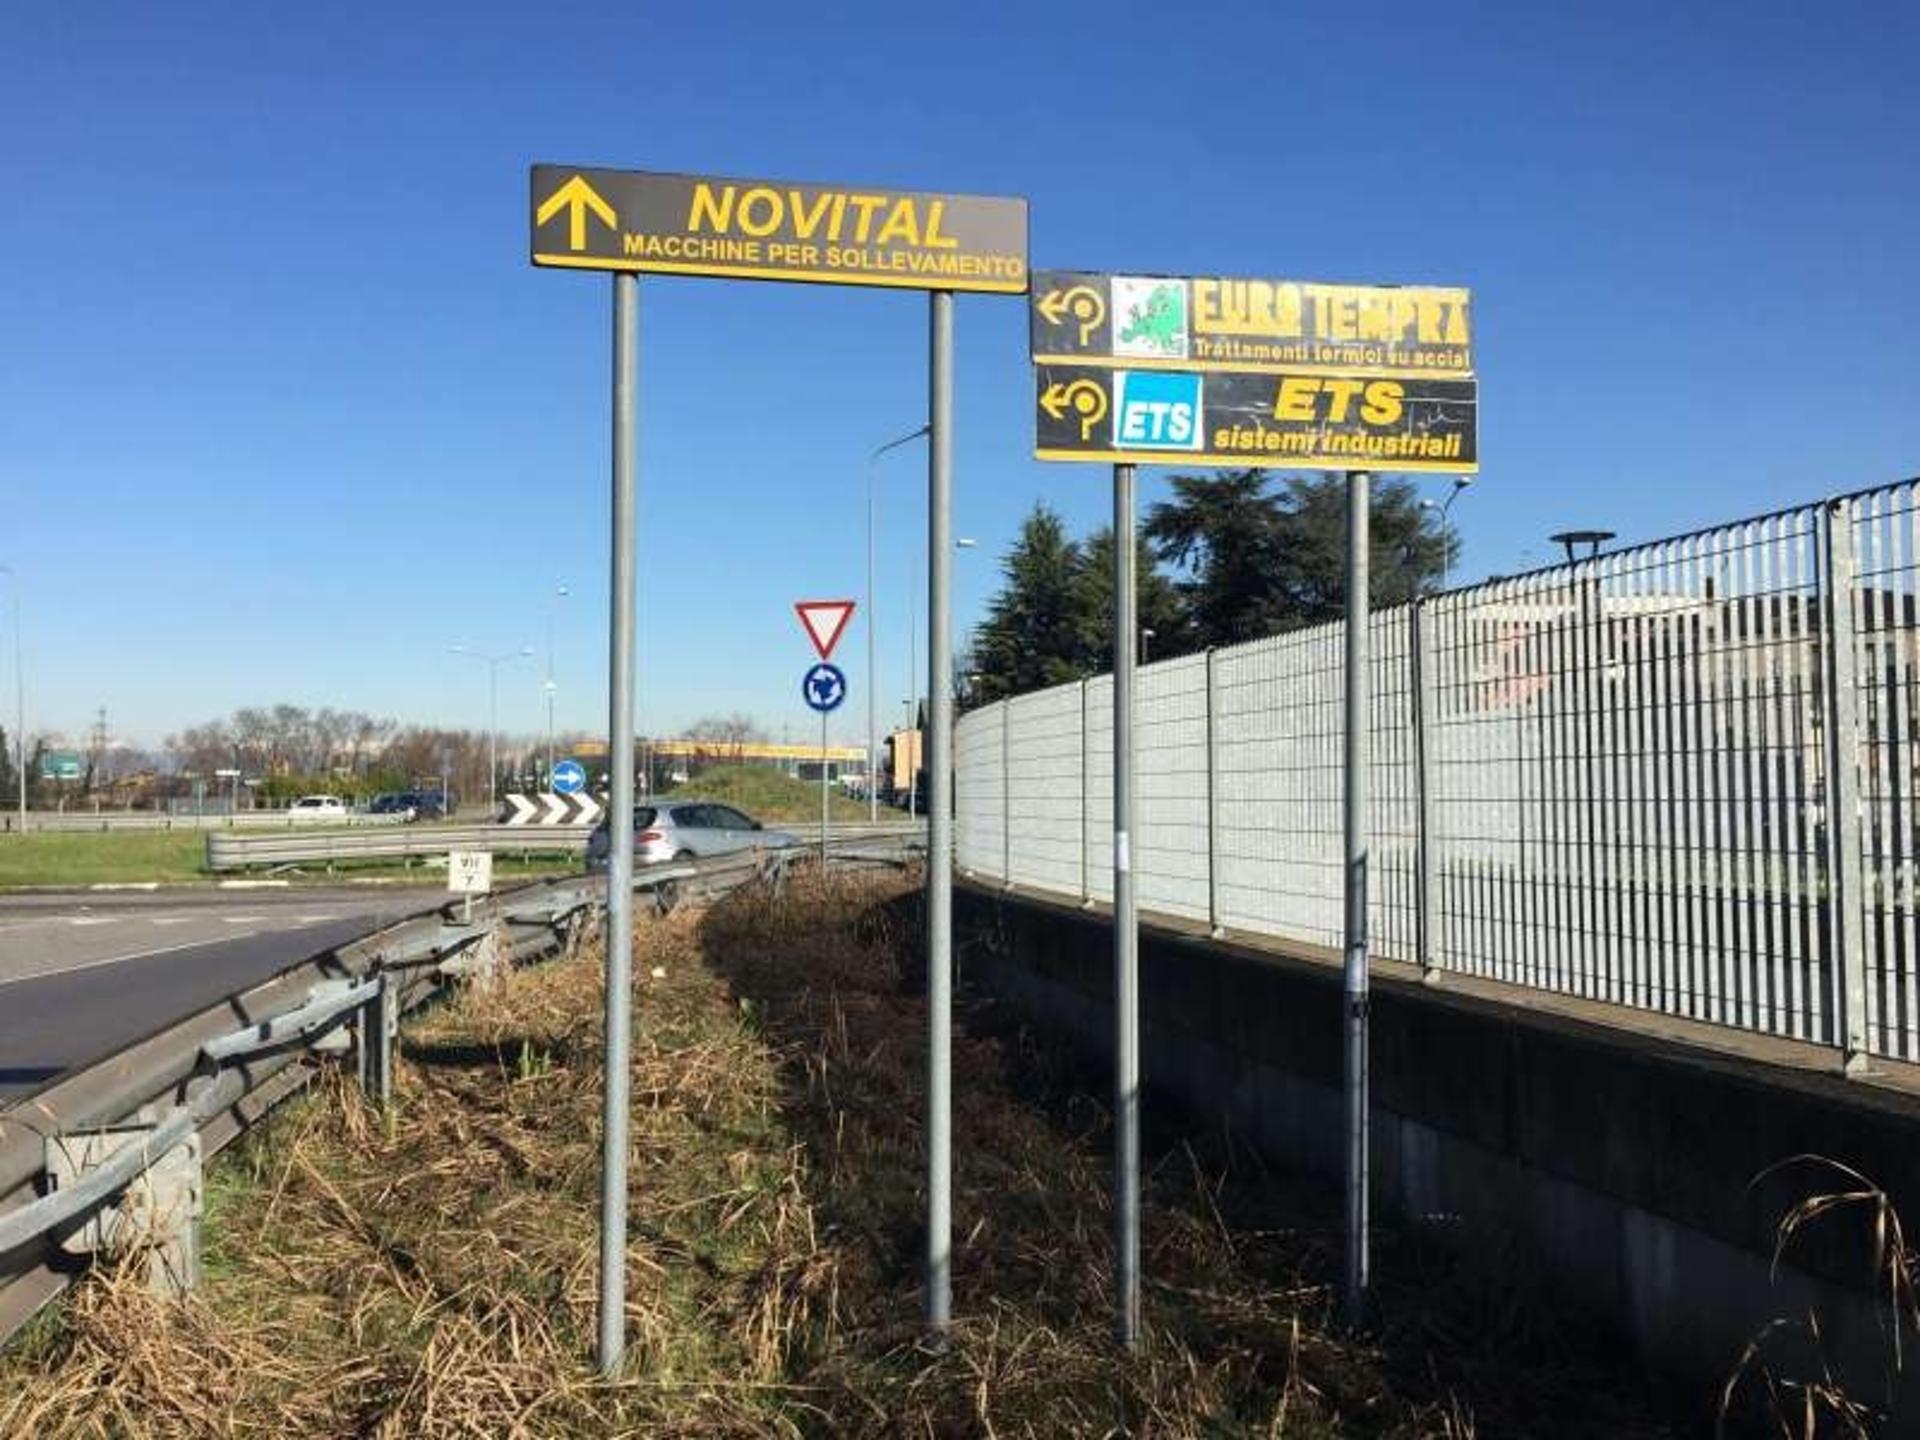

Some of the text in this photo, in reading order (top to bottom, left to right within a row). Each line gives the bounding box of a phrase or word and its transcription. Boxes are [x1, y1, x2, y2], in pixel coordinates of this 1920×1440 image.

[688, 184, 958, 249] NOVITAL
[623, 233, 1023, 278] MACCHINE PER SOLLEVAMENTO
[1123, 401, 1192, 441] ETS
[1274, 377, 1405, 425] ETS
[1214, 426, 1461, 457] sistemi industriali
